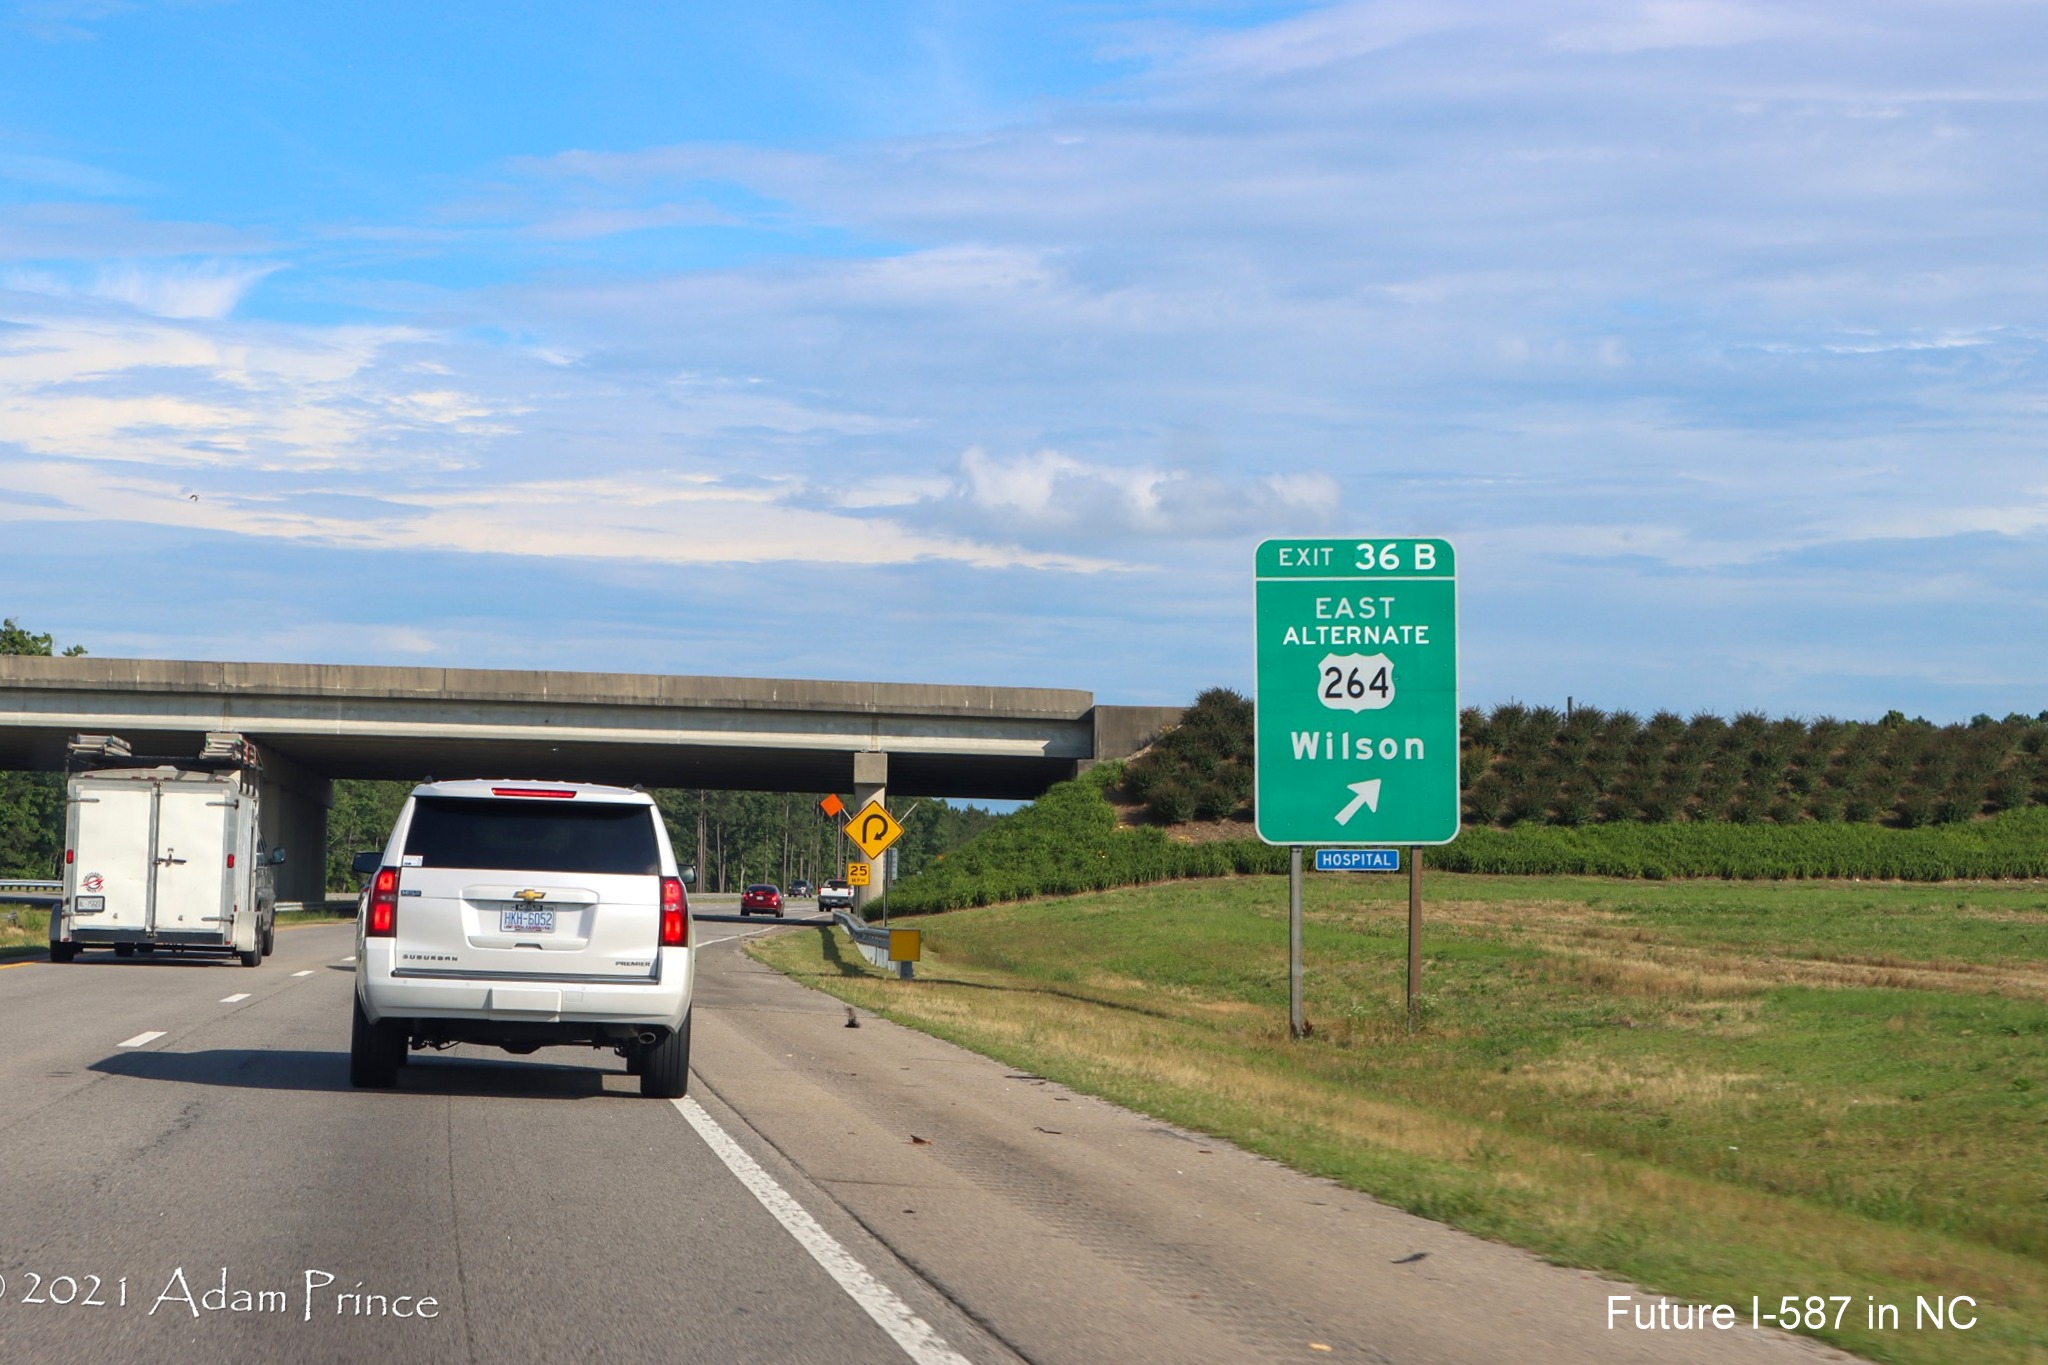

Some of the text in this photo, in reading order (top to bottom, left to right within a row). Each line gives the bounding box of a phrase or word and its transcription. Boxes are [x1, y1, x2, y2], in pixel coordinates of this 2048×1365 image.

[1279, 544, 1436, 570] EXIT 36 B
[1316, 597, 1396, 619] EAST
[1283, 626, 1429, 645] ALTERNATE
[1324, 667, 1389, 698] 264
[1291, 732, 1424, 760] Wilson
[1323, 854, 1391, 866] HOSPITAL
[850, 865, 868, 876] 25
[505, 912, 553, 926] HKH-6052
[402, 953, 458, 961] SUBURBAN
